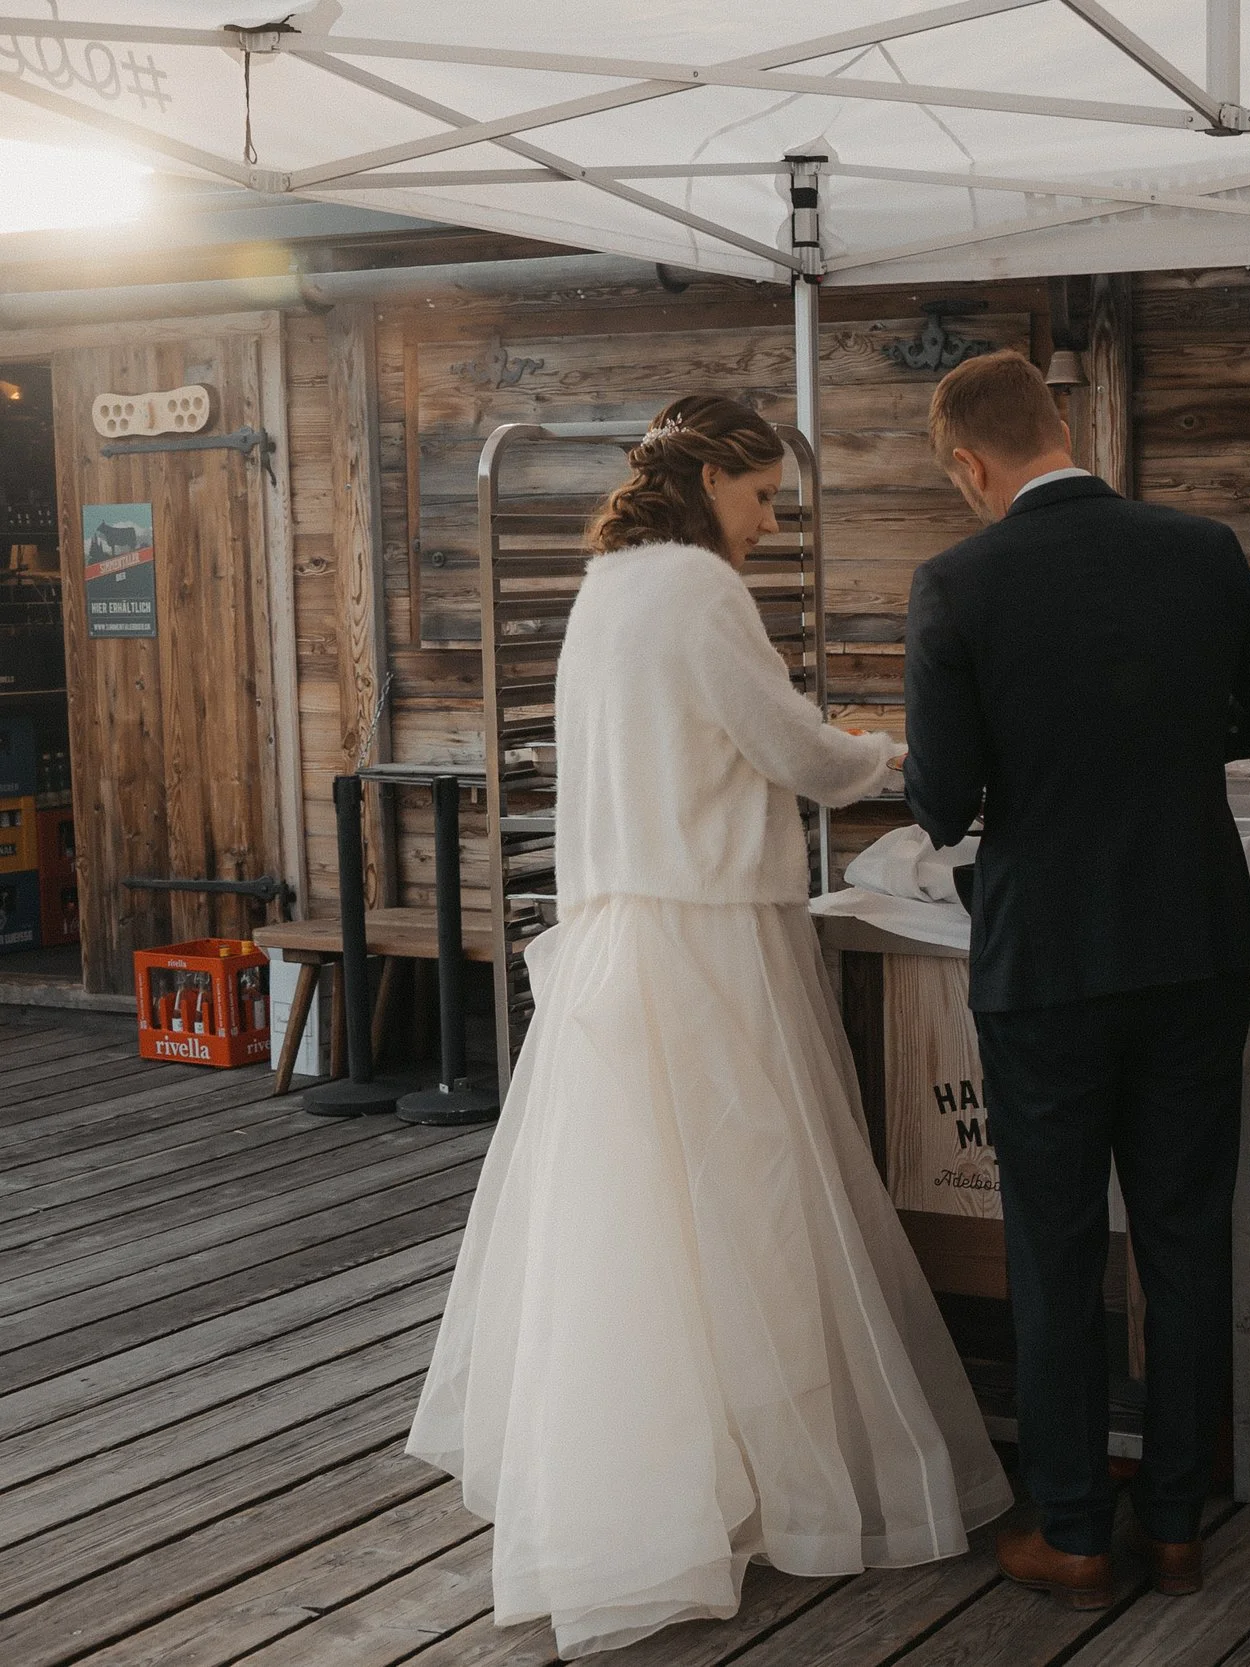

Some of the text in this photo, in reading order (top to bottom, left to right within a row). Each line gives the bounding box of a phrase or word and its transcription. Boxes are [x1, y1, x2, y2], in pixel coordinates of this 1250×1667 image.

[91, 600, 151, 614] HIER ERHÄLTLICH
[167, 959, 187, 968] rivella
[155, 1035, 211, 1060] rivella
[933, 1080, 985, 1115] HA
[956, 1118, 992, 1149] M
